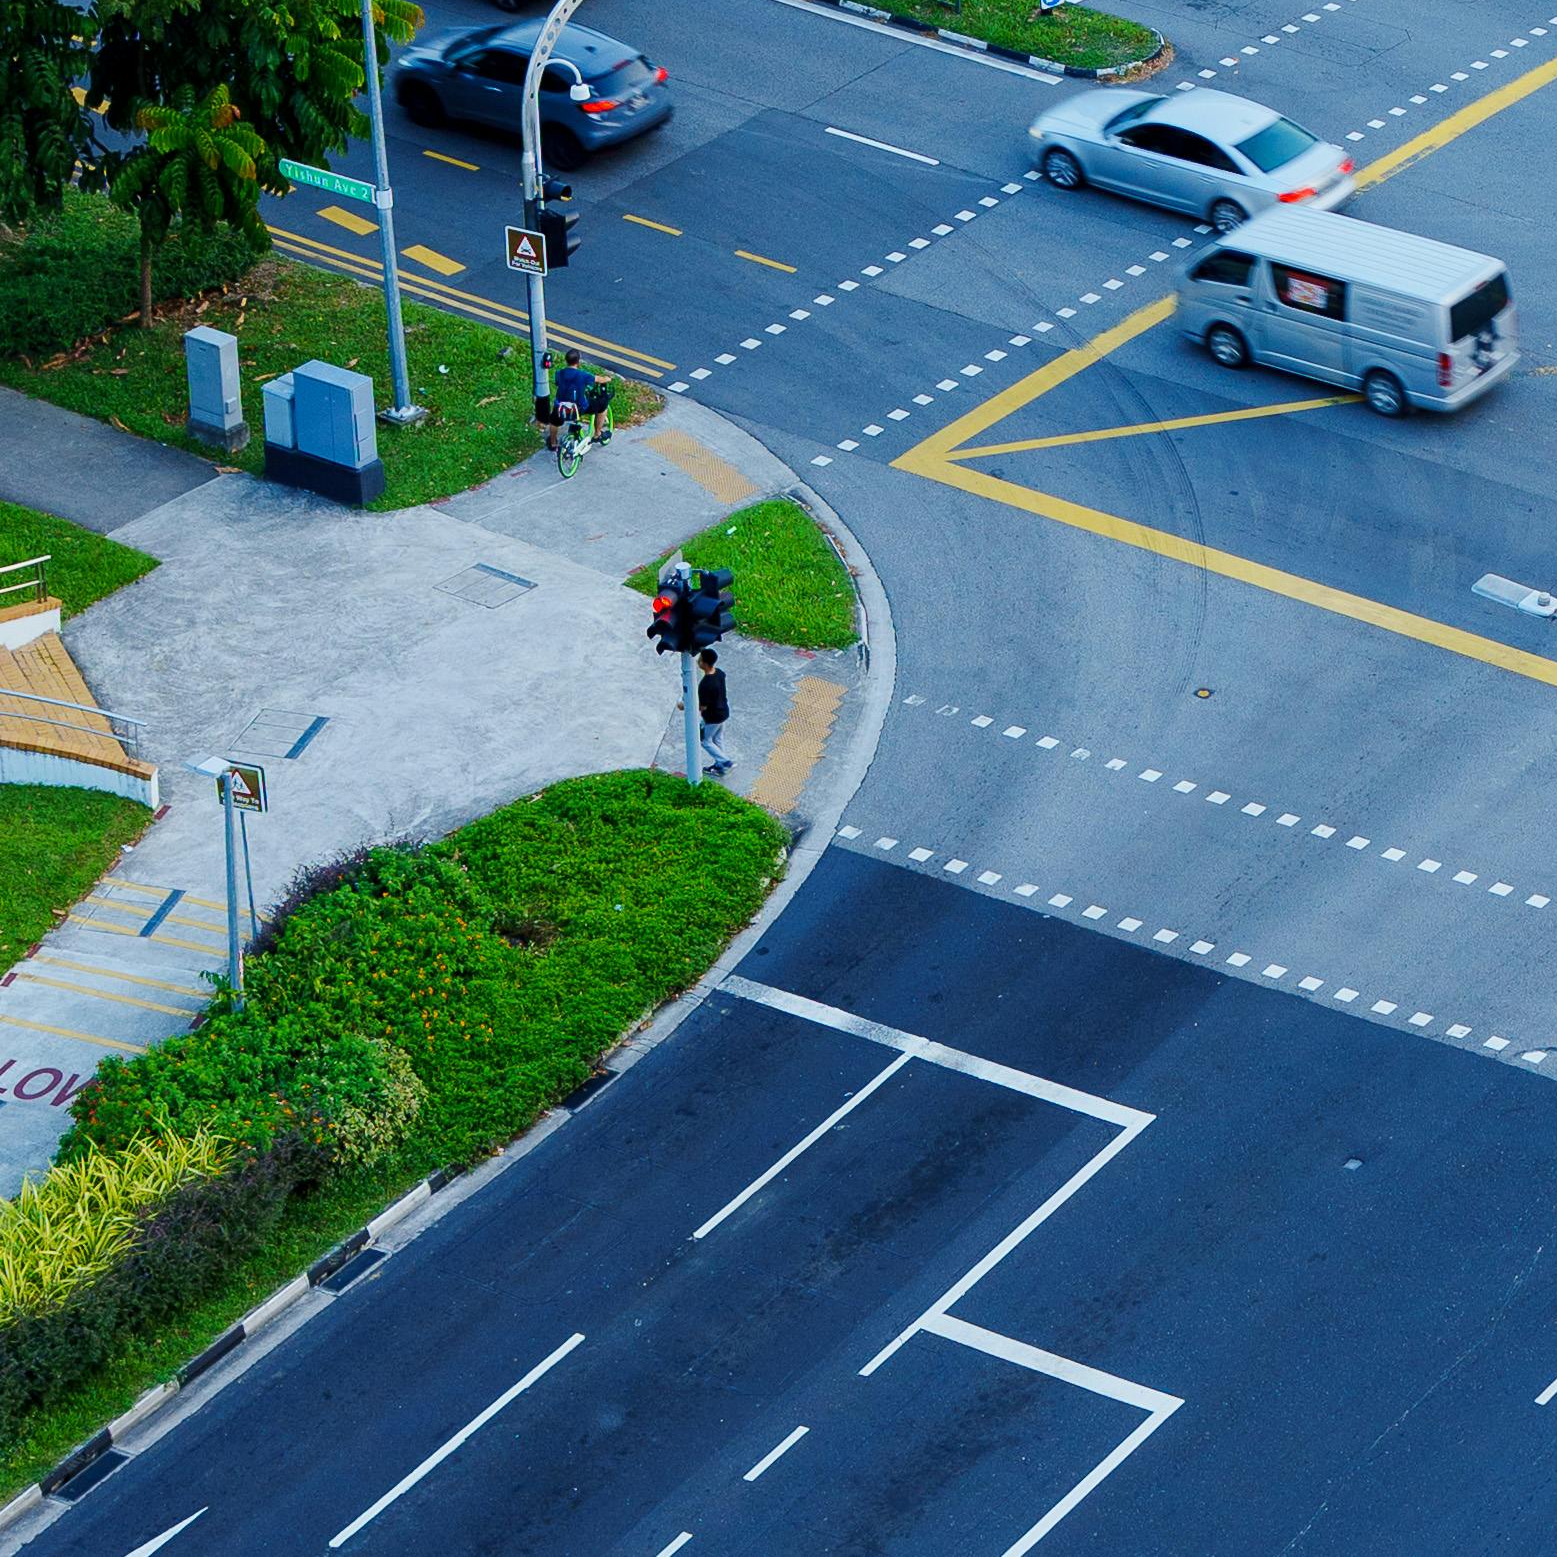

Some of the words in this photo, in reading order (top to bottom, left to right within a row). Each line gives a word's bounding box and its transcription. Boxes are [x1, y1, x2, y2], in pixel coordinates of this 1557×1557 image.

[286, 163, 328, 187] Yishun
[334, 179, 356, 196] Ave
[361, 187, 368, 199] 2
